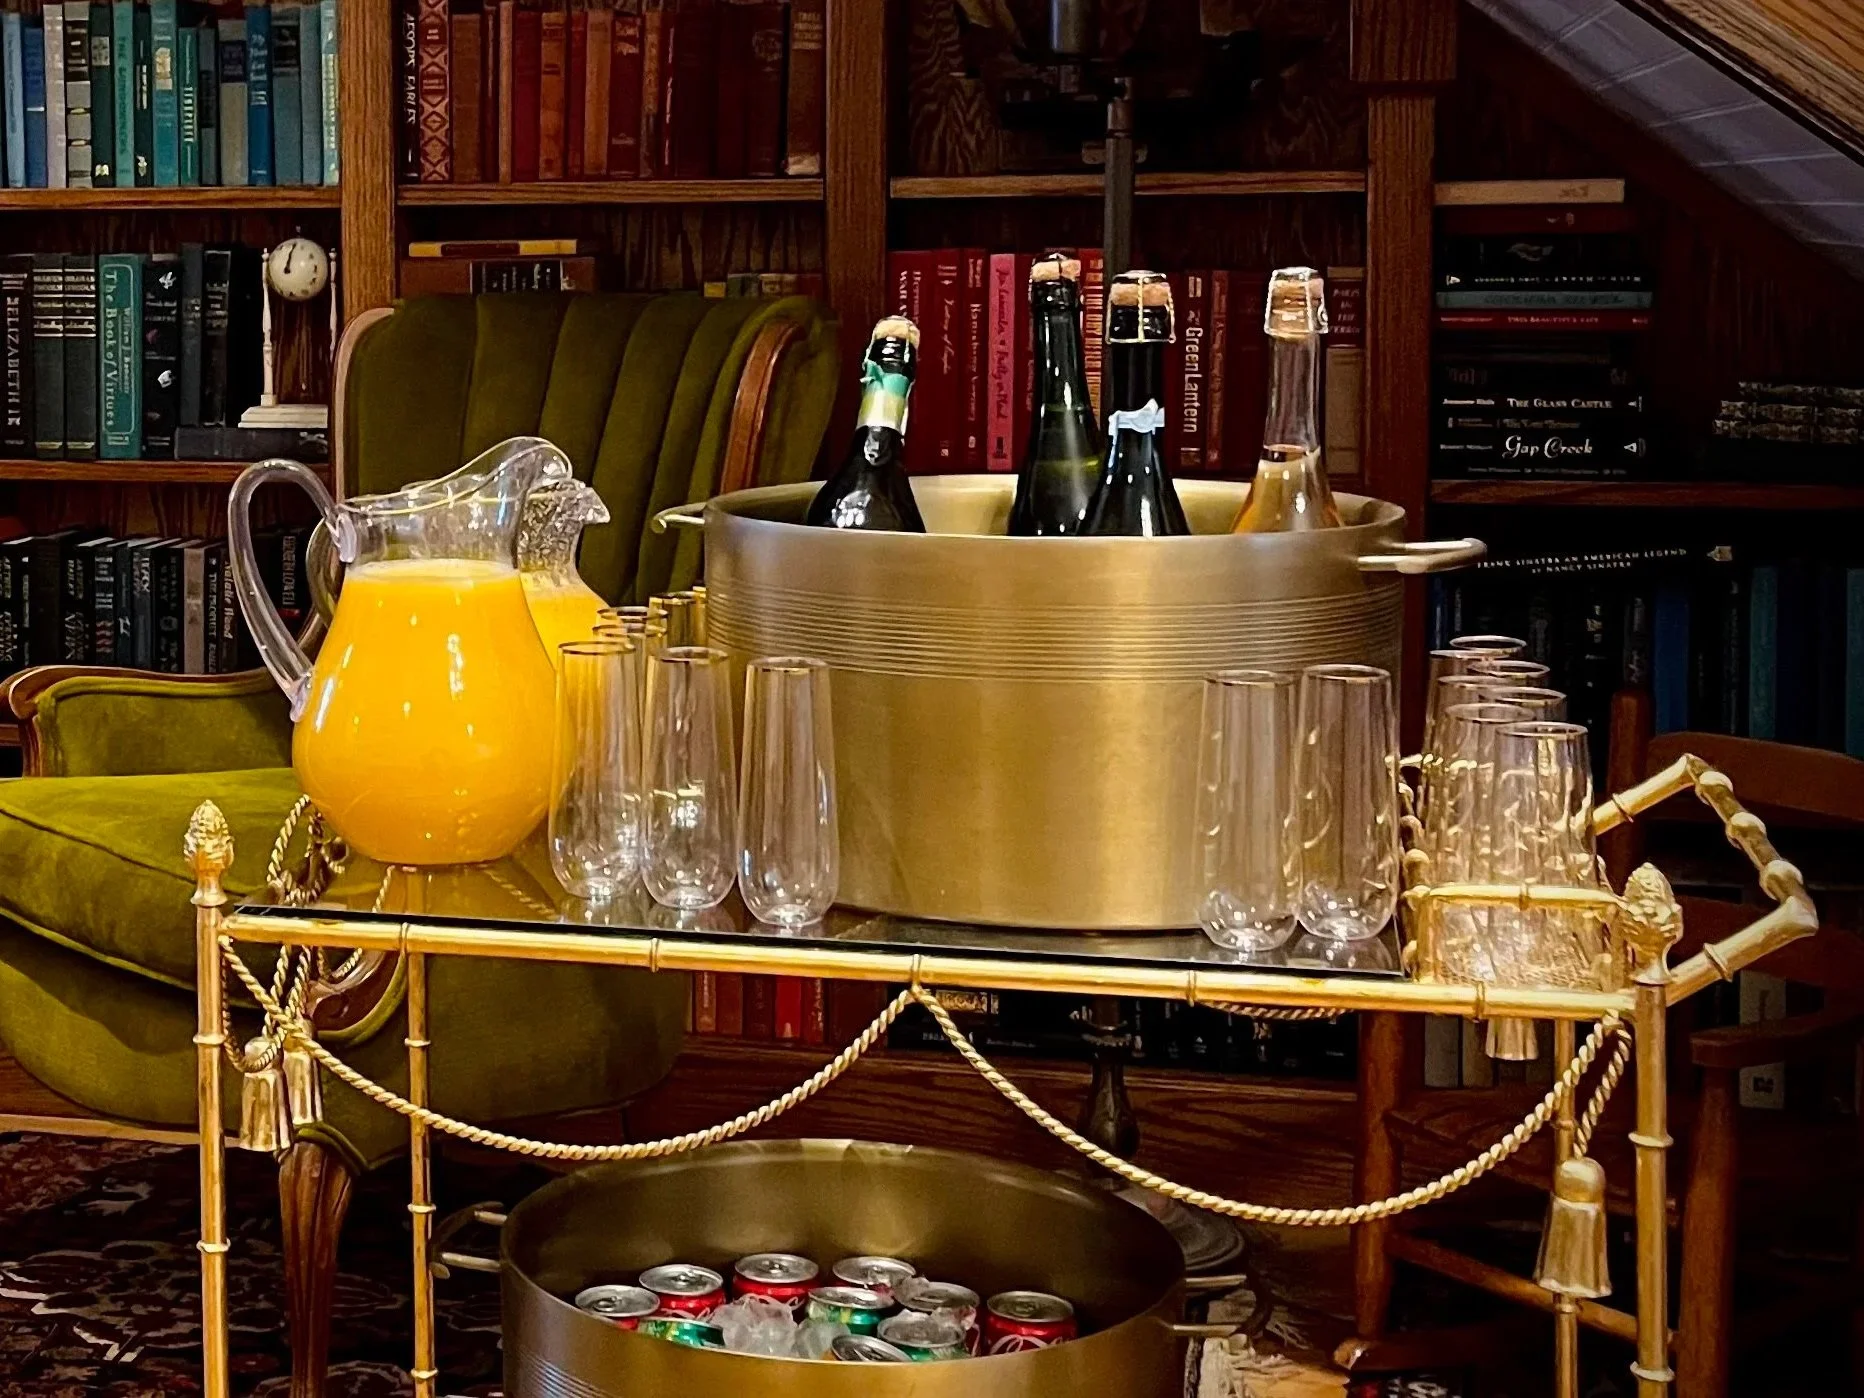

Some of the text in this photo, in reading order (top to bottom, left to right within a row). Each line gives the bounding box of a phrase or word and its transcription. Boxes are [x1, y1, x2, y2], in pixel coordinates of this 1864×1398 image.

[103, 270, 118, 427] The Book of Virtues
[1502, 434, 1593, 459] Gap Creek
[1583, 552, 1639, 562] AMERICAN
[223, 607, 234, 640] Wood
